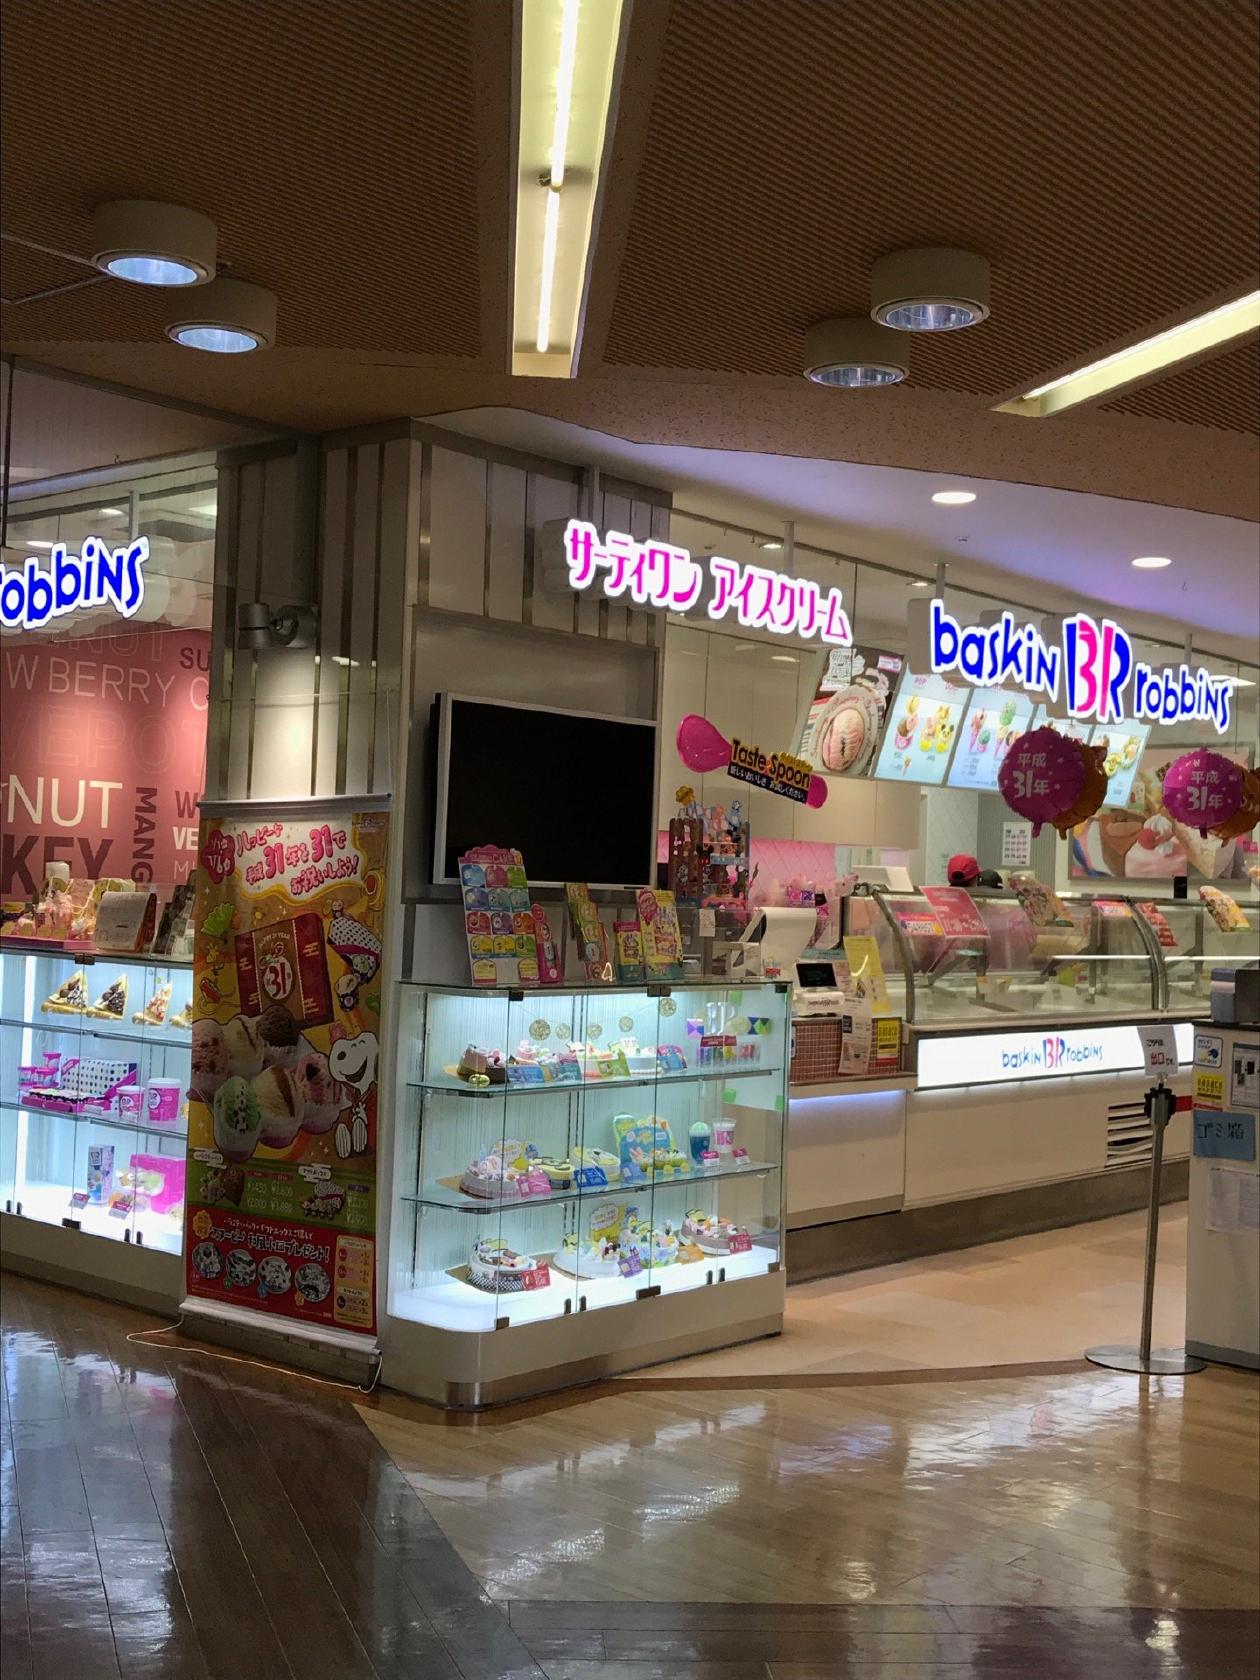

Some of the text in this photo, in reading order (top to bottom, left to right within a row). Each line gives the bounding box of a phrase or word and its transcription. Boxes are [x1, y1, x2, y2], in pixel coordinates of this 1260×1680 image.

[0, 544, 143, 623] obbins
[569, 525, 850, 641] サーティワン アイスクリーム
[933, 605, 1058, 701] baskin
[1065, 617, 1131, 719] BR
[1135, 667, 1232, 728] robbins
[732, 738, 811, 789] Taste Spoon
[1016, 752, 1047, 768] 平成
[1012, 770, 1050, 798] 31年
[1191, 770, 1221, 785] 平成
[2, 775, 123, 828] NUT
[1186, 785, 1224, 811] 31年
[268, 962, 287, 998] 31
[1002, 1047, 1041, 1068] baskin
[1066, 1044, 1103, 1061] robbins
[1197, 1121, 1245, 1141] ゴミ箱
